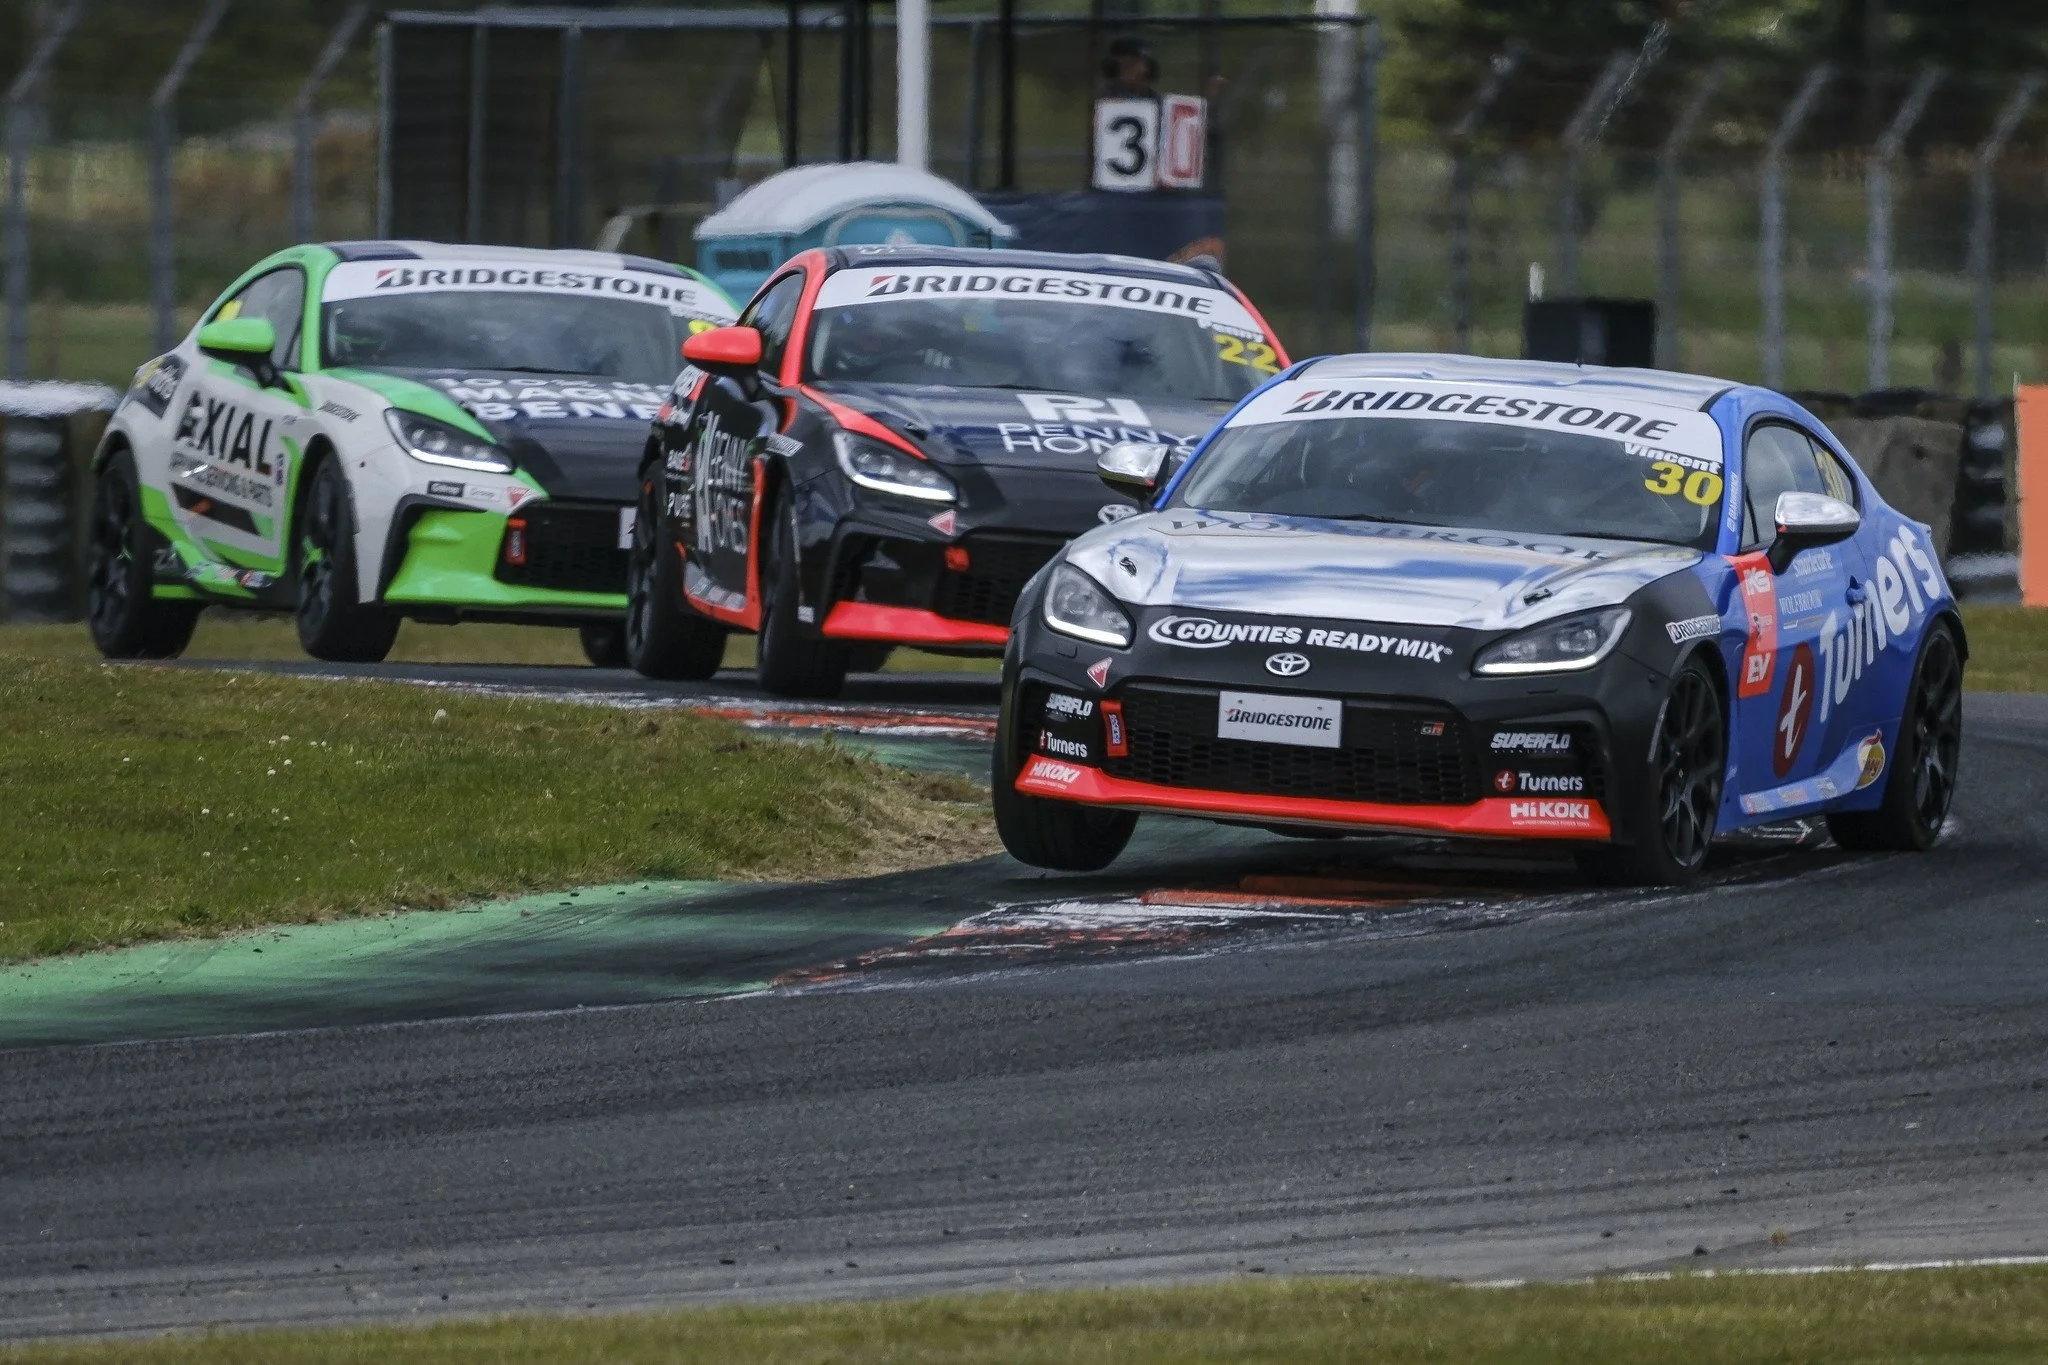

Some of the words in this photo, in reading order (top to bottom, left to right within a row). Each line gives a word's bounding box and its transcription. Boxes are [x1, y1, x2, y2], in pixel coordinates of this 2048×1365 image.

[1107, 115, 1147, 176] 3
[375, 267, 697, 305] BRIDGESTONE
[865, 274, 1214, 315] BRIDGESTONE
[1213, 333, 1281, 374] 22
[1281, 390, 1678, 441] BRIDGESTONE
[997, 422, 1201, 446] PENNY
[1001, 434, 1195, 464] HOS
[1624, 441, 1721, 475] Vincent
[1644, 460, 1723, 507] 30
[1176, 621, 1304, 645] COUNTIES
[1819, 524, 1941, 724] Turners
[1045, 692, 1094, 717] SUPERFLO
[1225, 707, 1334, 731] BRIDGESTONE
[1046, 731, 1088, 758] Turners
[1490, 732, 1571, 749] SUPERFLO
[1518, 772, 1583, 791] Turners
